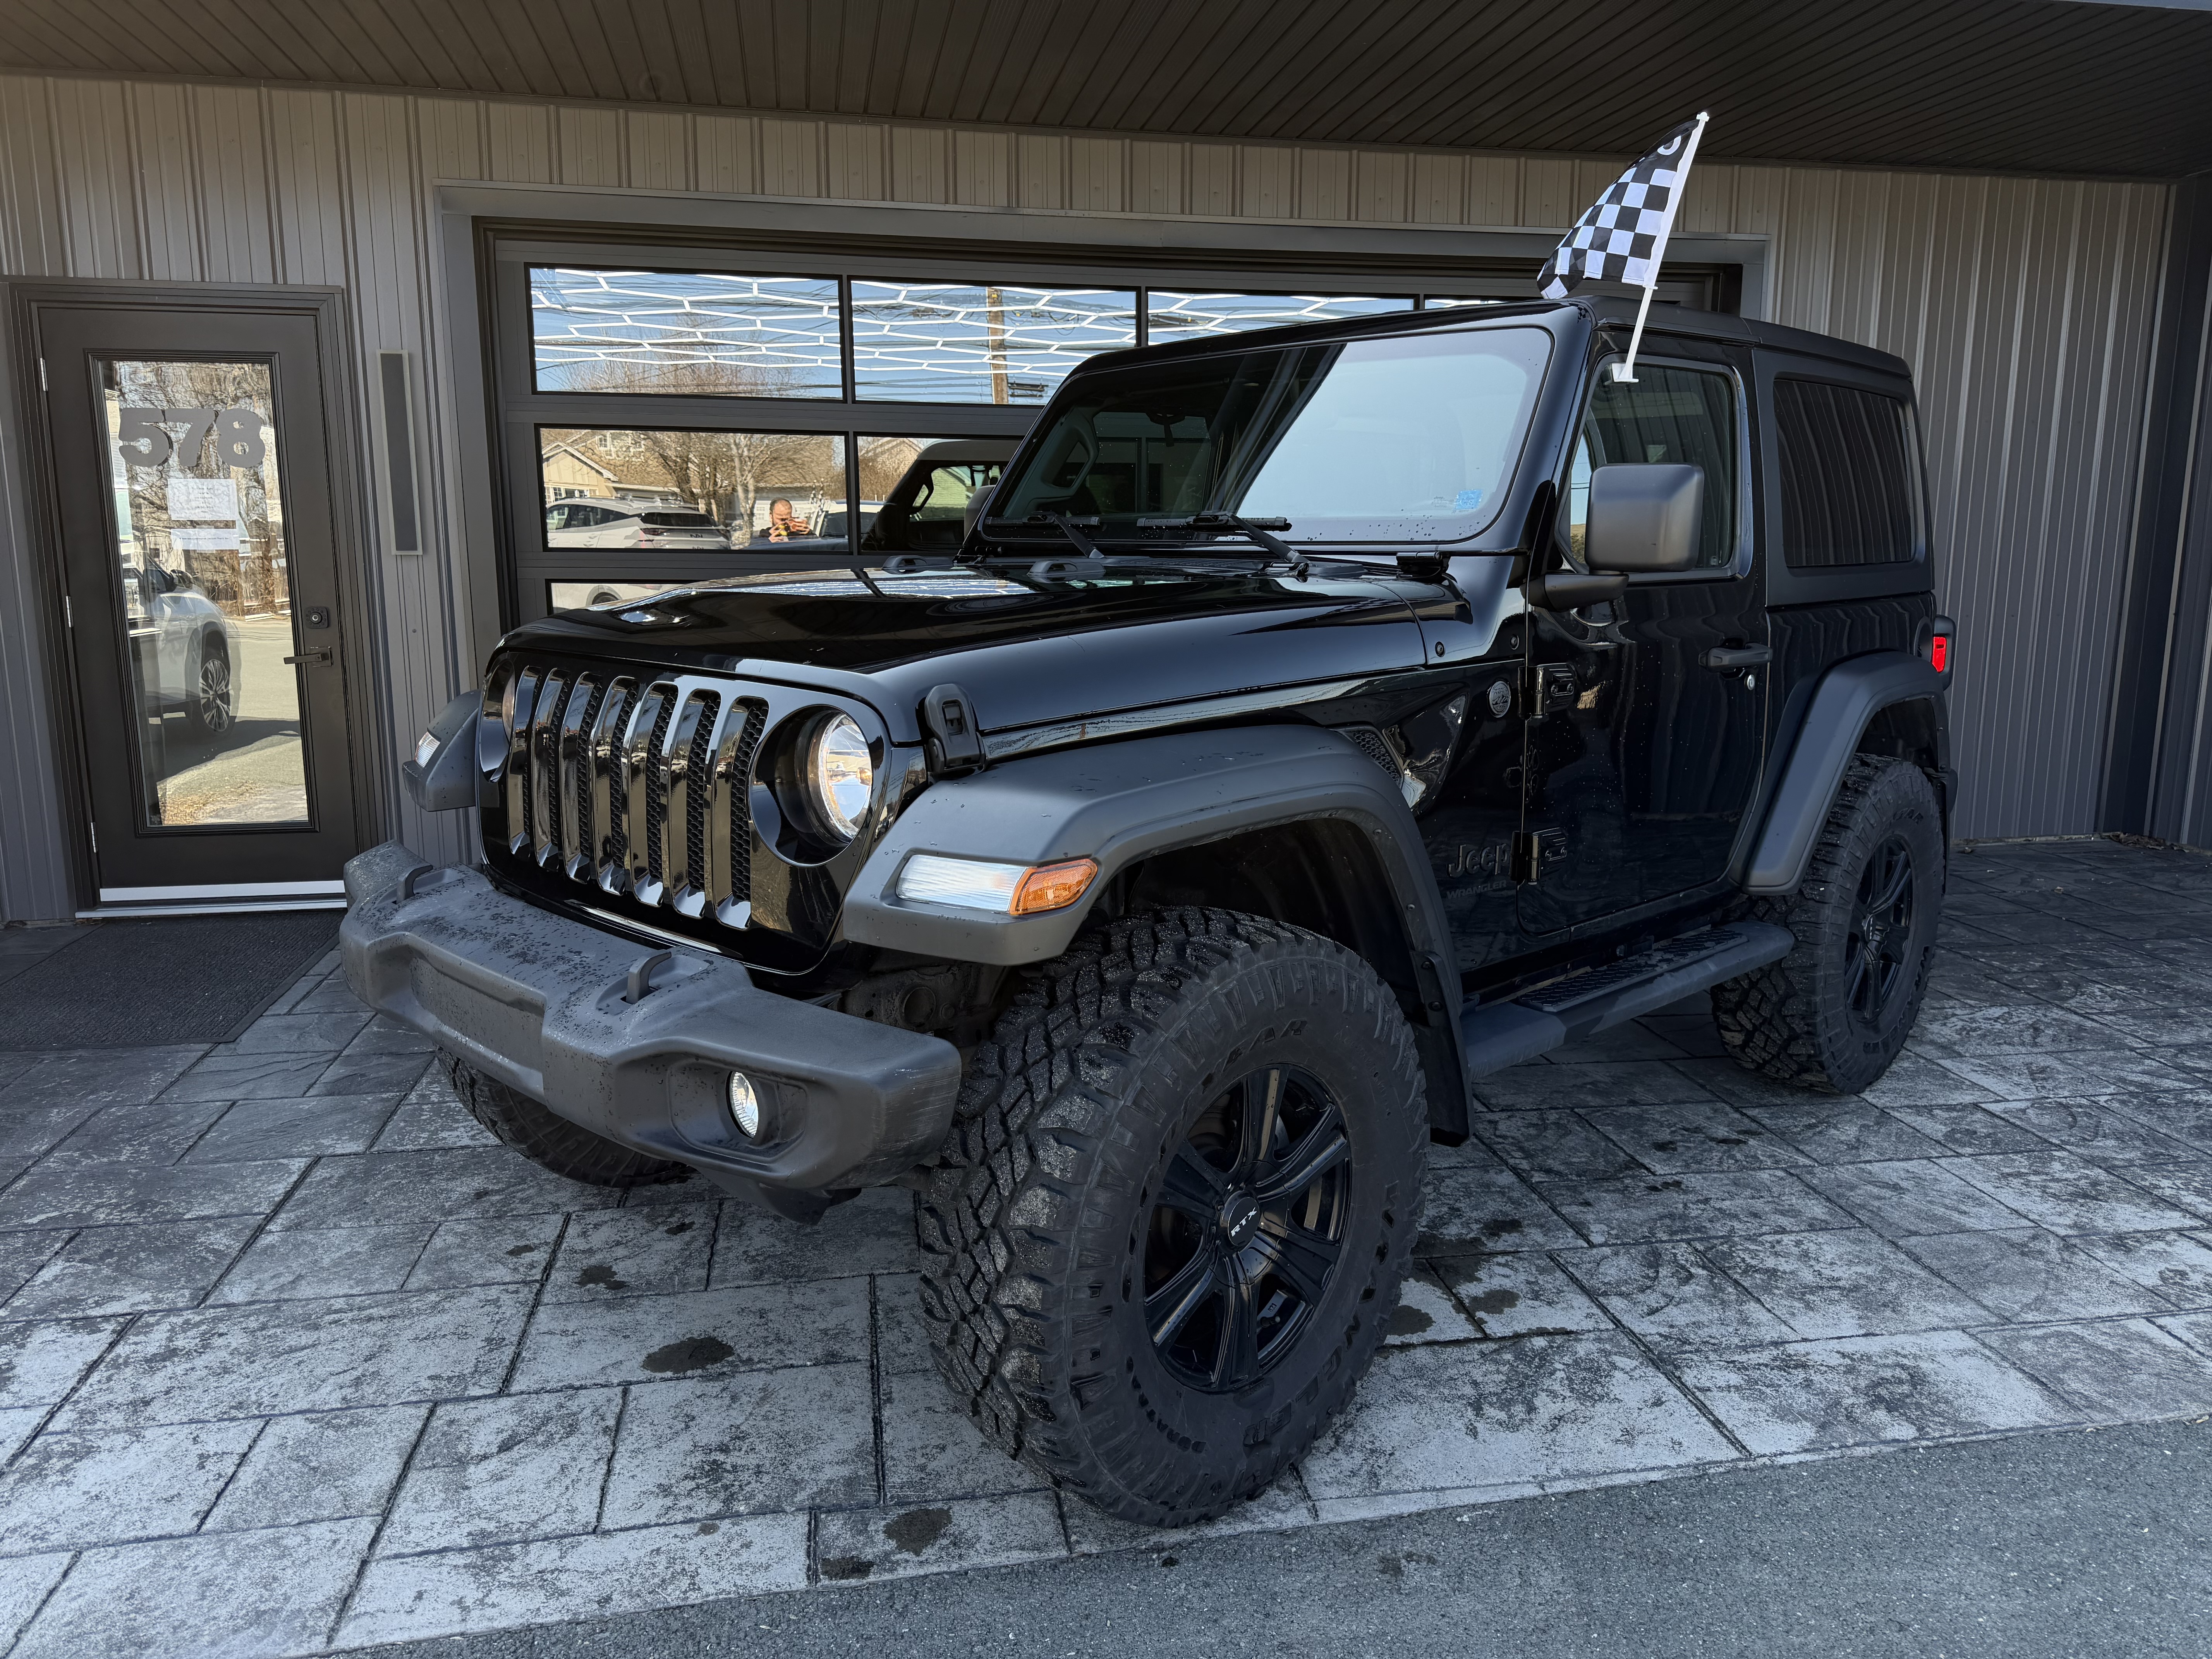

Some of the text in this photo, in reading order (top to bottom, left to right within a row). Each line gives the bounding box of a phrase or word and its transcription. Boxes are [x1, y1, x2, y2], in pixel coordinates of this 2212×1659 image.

[118, 408, 266, 468] 578
[1447, 843, 1510, 879] Jeep
[1446, 880, 1506, 899] WRANGLER
[1231, 1207, 1257, 1237] RTX
